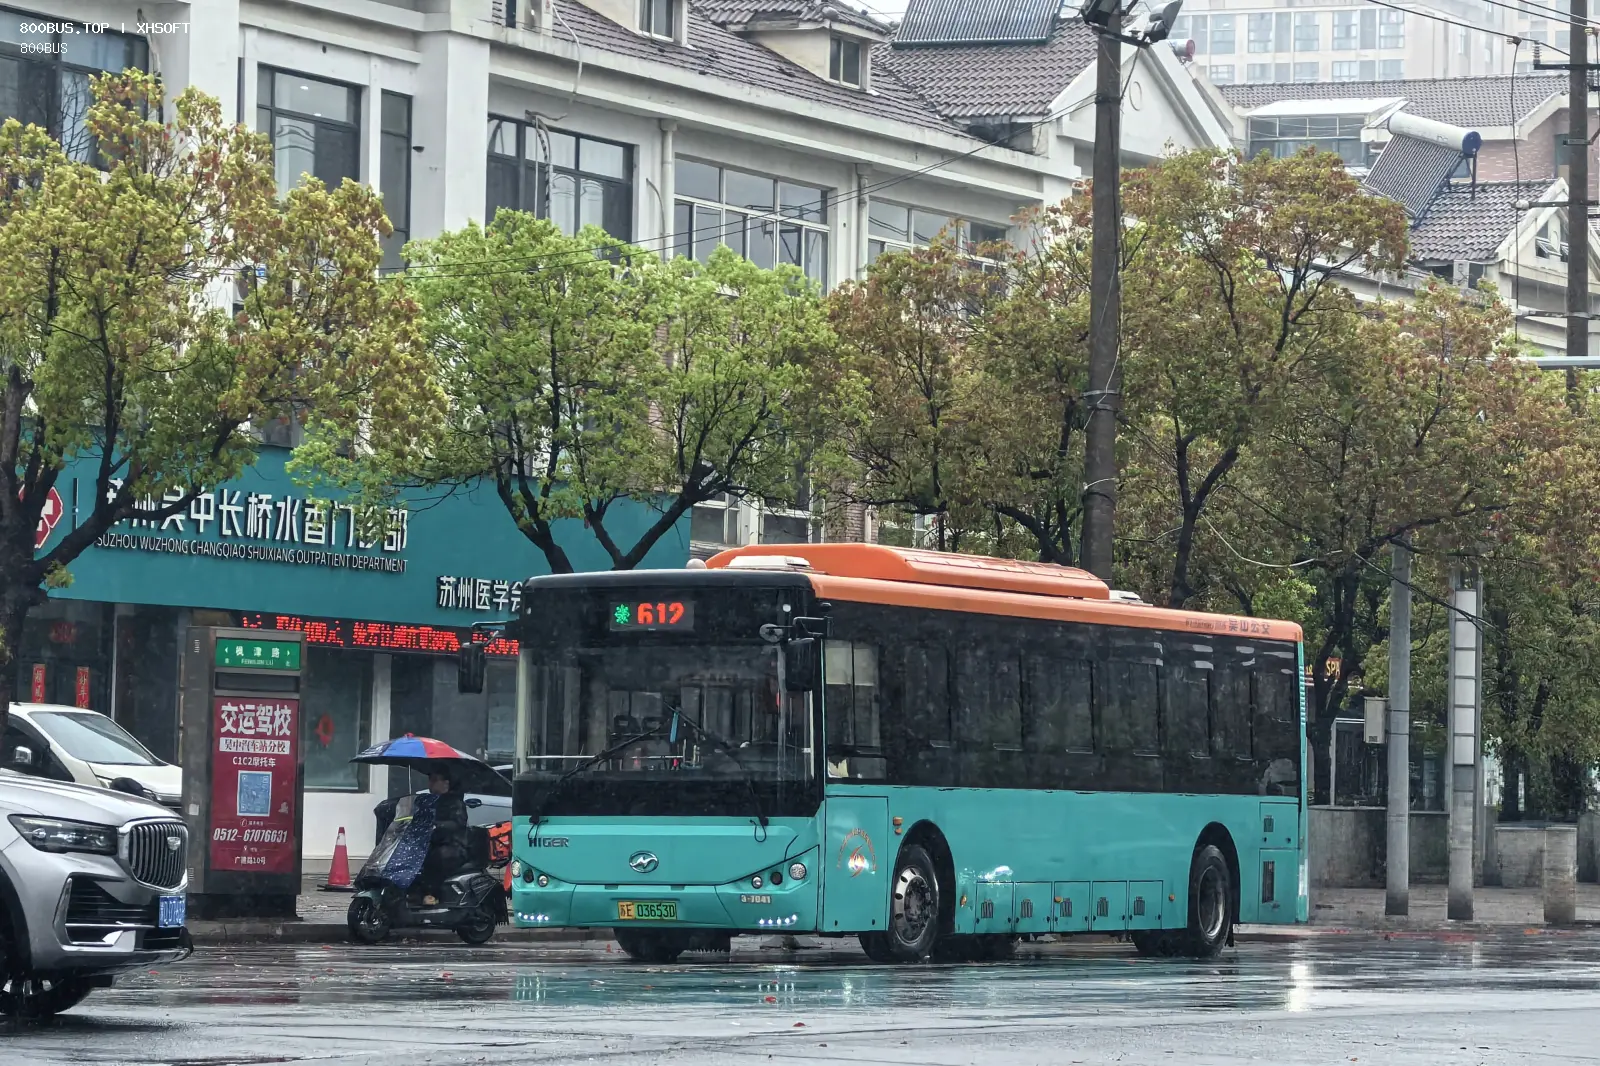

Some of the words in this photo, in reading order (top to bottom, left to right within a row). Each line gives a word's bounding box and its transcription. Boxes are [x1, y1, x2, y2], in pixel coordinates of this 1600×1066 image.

[97, 533, 138, 549] SUZHOU
[140, 535, 188, 554] WUZHONG
[190, 540, 246, 560] CHANGQIAO
[247, 546, 295, 563] SHUIXIANG
[297, 549, 351, 568] OUTPATIENT
[352, 554, 408, 573] DEPARTMENT
[637, 602, 685, 624] 612
[220, 702, 292, 737] 交运驾校
[225, 738, 286, 753] 吴中汽车站分校
[232, 756, 276, 768] C1C2摩托车
[213, 828, 288, 843] 0512-67076631
[528, 836, 569, 848] HIGER
